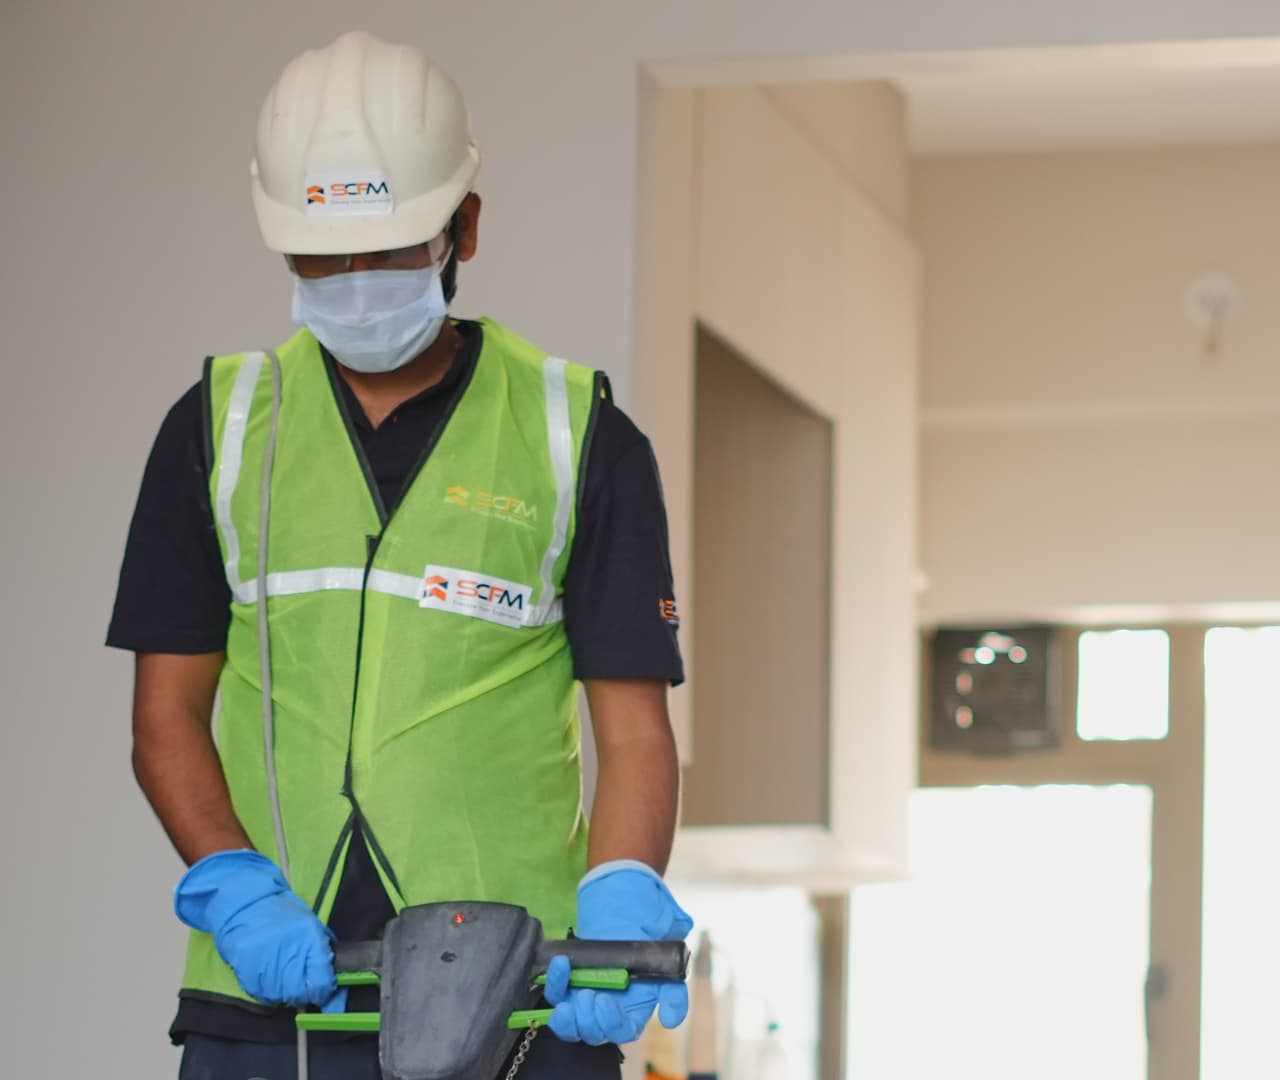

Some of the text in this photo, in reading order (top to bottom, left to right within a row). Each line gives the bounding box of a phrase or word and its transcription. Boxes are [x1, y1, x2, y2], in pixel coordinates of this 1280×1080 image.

[330, 181, 389, 196] SCFM
[475, 491, 537, 522] SCFM
[456, 579, 523, 610] SCFM
